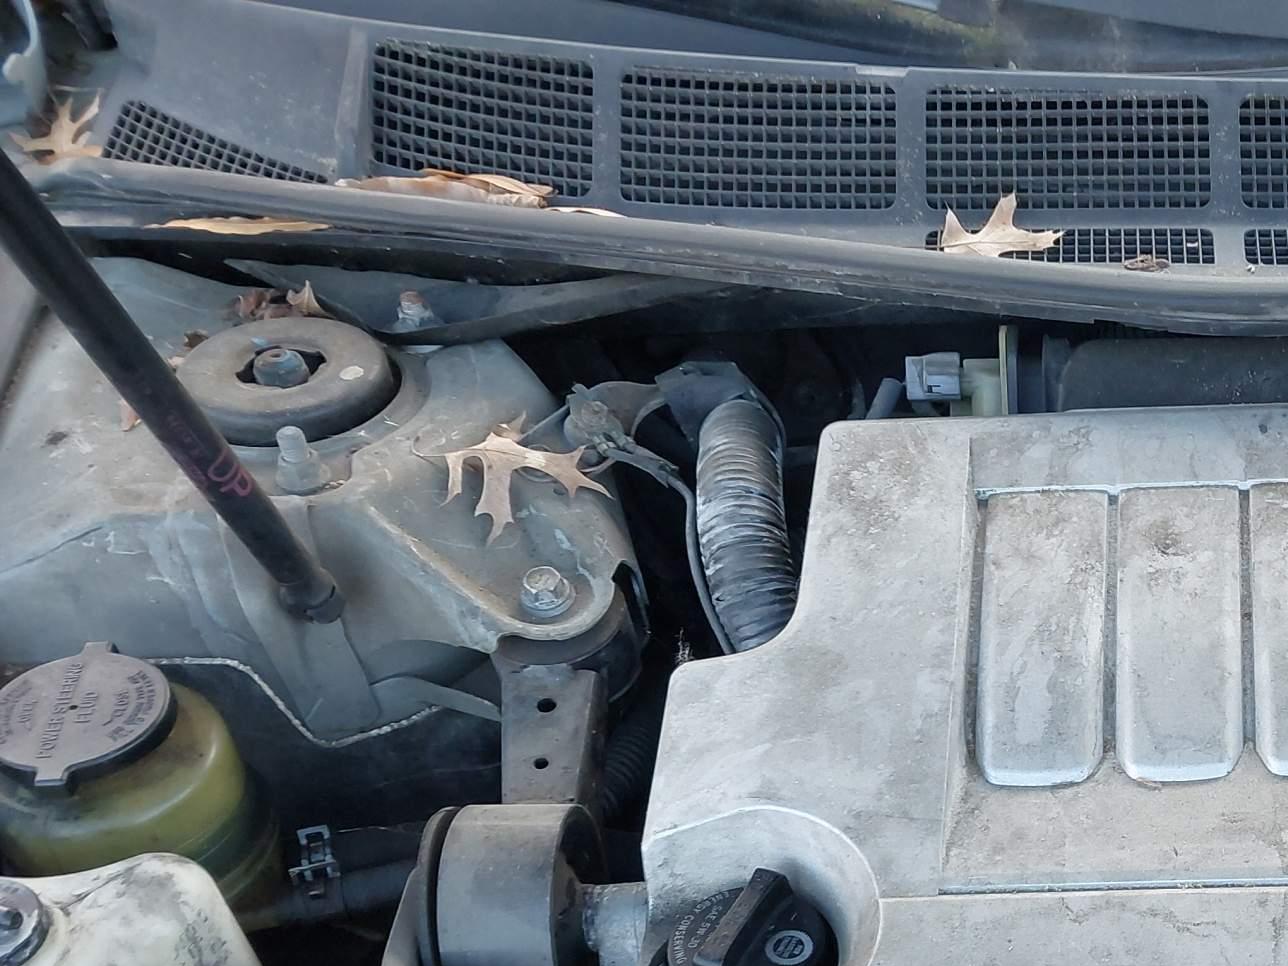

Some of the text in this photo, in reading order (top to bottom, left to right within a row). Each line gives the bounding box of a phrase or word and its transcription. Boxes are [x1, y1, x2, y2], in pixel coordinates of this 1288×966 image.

[207, 448, 254, 496] UP
[36, 663, 84, 759] POWER STEERING
[74, 691, 98, 723] FLUID
[673, 891, 730, 965] ENERGY CONSERVING
